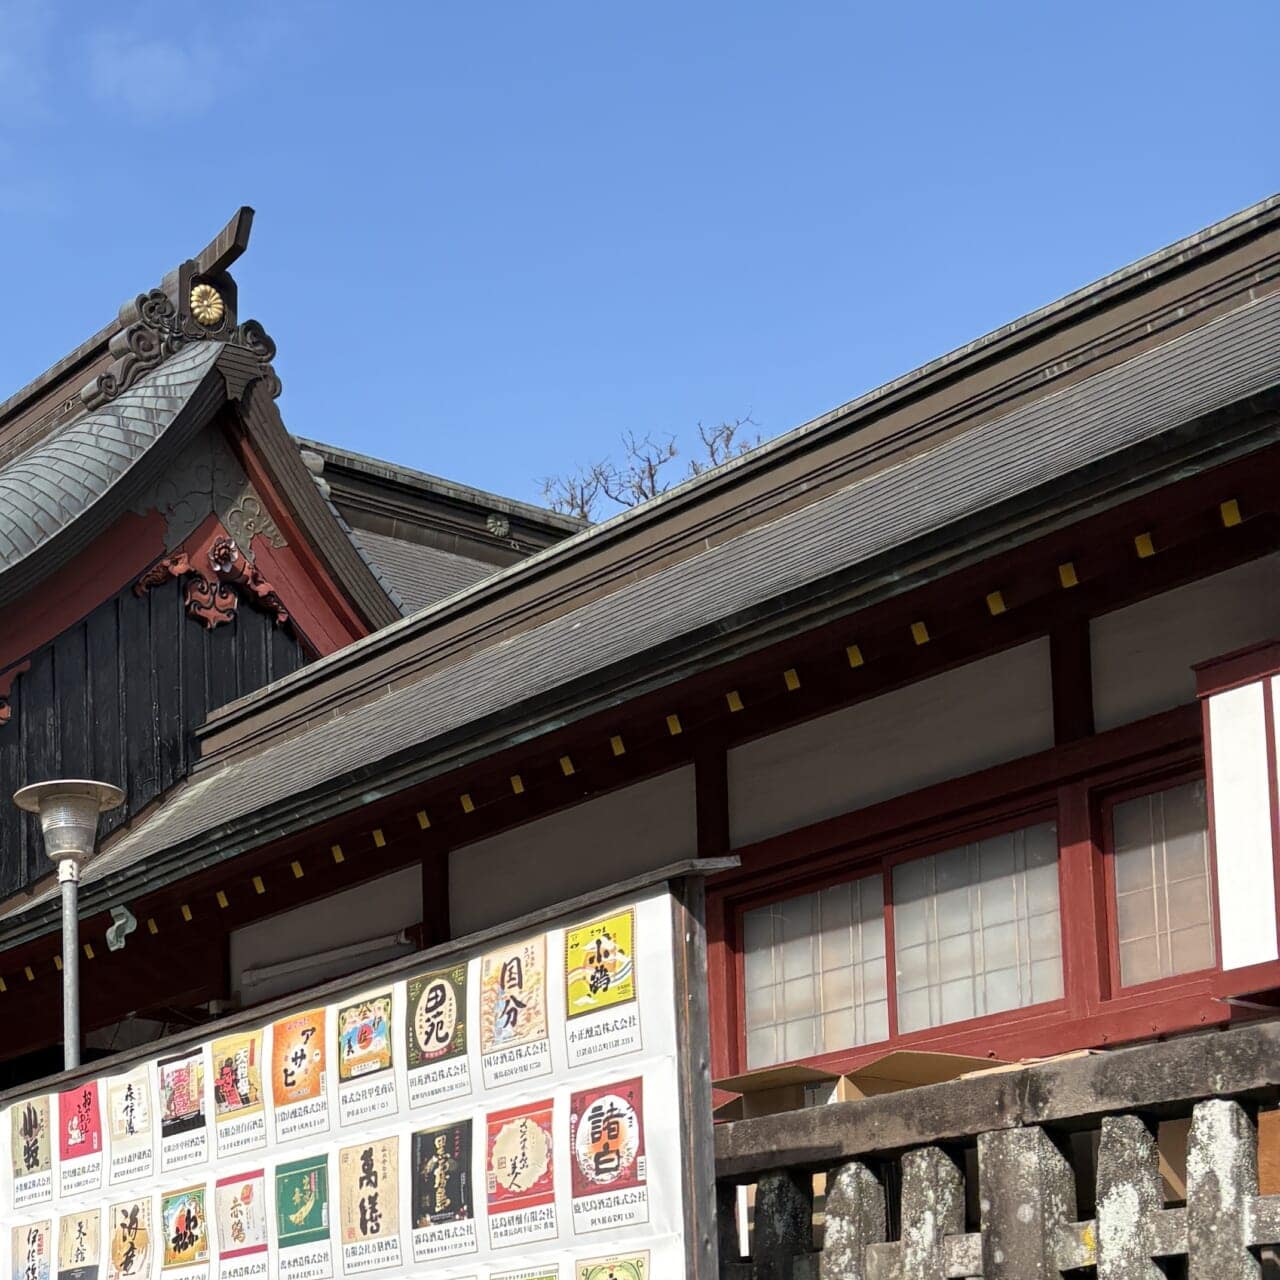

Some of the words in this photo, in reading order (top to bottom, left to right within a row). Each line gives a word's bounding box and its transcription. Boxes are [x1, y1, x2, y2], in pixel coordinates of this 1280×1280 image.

[423, 983, 450, 1046] 田苑
[500, 956, 527, 1029] 国分
[588, 1101, 627, 1176] 諸白
